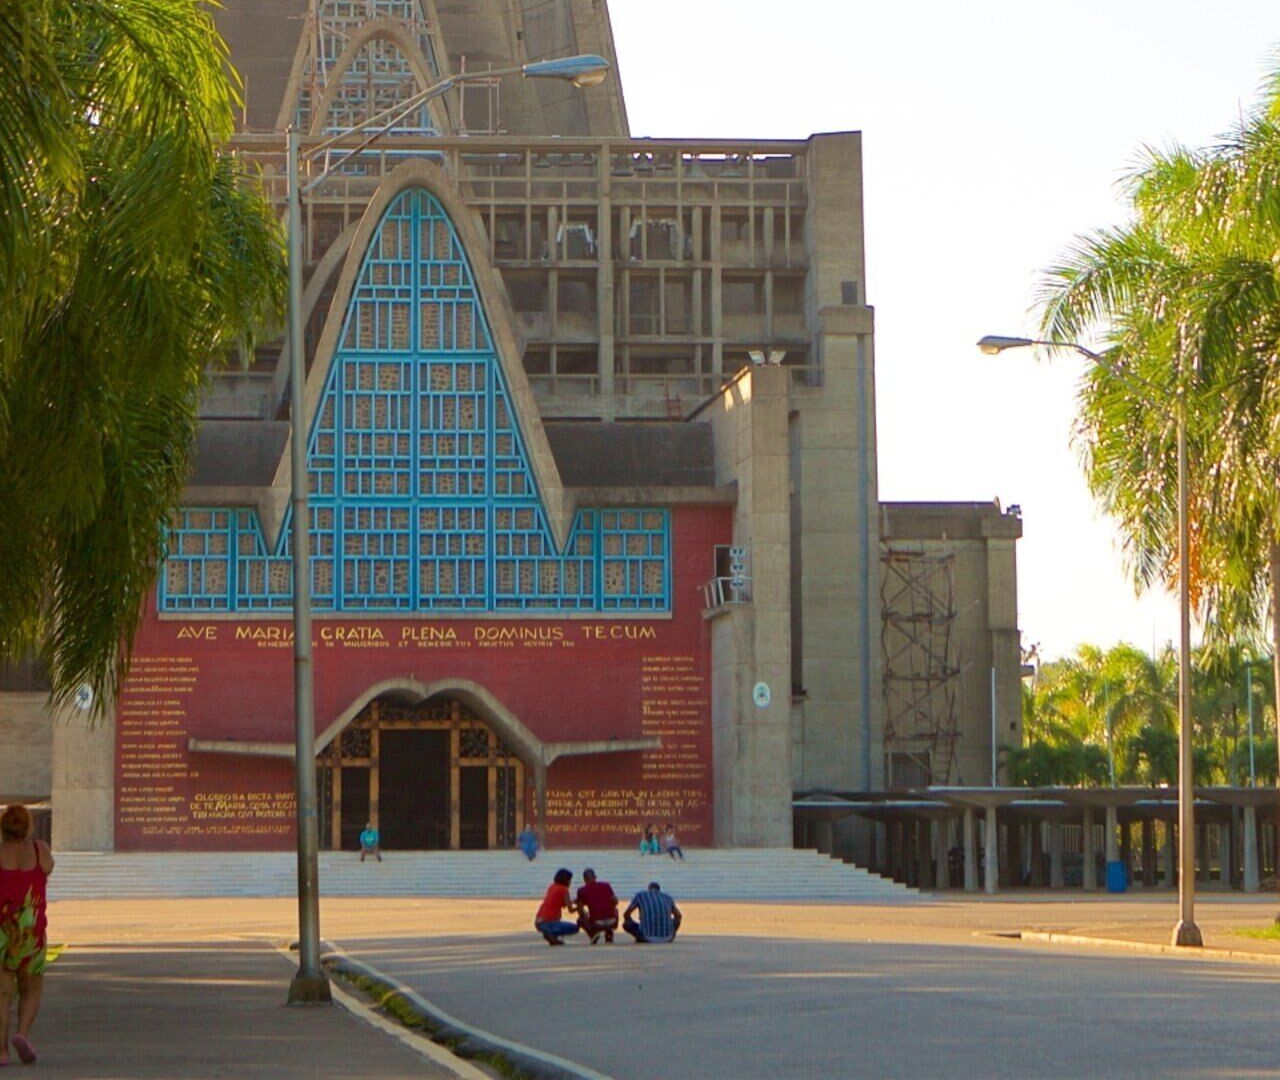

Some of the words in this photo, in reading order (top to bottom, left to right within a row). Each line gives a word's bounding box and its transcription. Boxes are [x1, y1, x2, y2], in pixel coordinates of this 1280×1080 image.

[176, 625, 217, 640] AVE
[402, 625, 457, 640] PLENA
[474, 625, 564, 640] DOMINUS
[582, 625, 657, 639] TECUM
